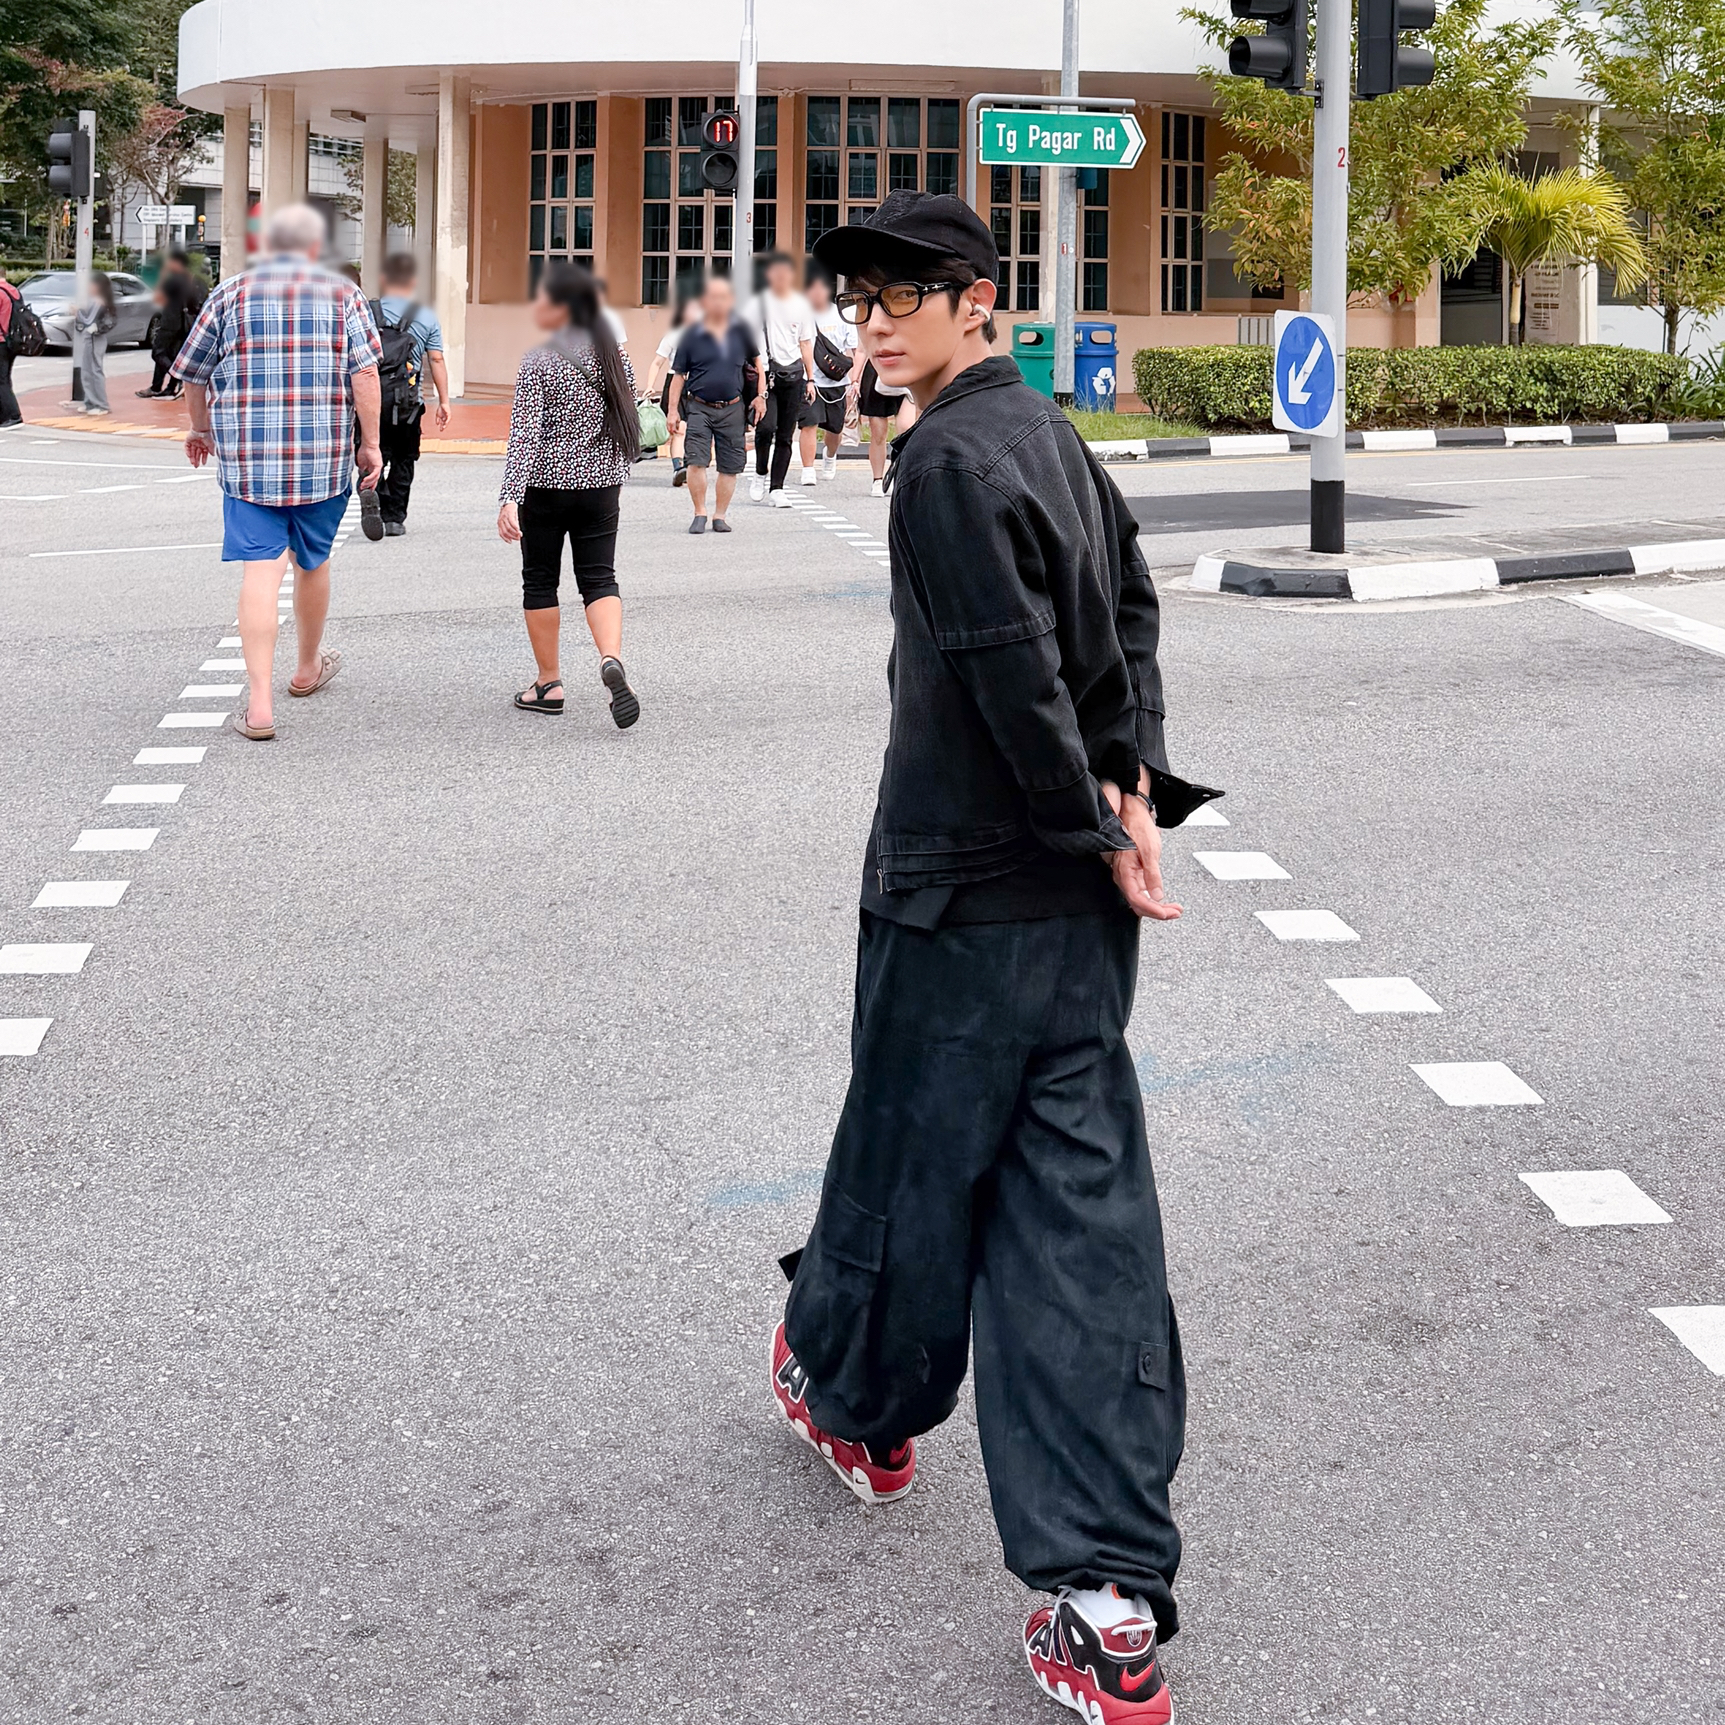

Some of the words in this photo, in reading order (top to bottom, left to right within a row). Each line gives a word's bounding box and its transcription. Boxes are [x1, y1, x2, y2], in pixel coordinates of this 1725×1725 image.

[714, 120, 734, 142] 17
[995, 123, 1017, 154] Tg
[1028, 124, 1083, 155] Pagar
[1093, 127, 1116, 151] Rd
[1337, 146, 1346, 168] 2
[746, 211, 752, 224] 3
